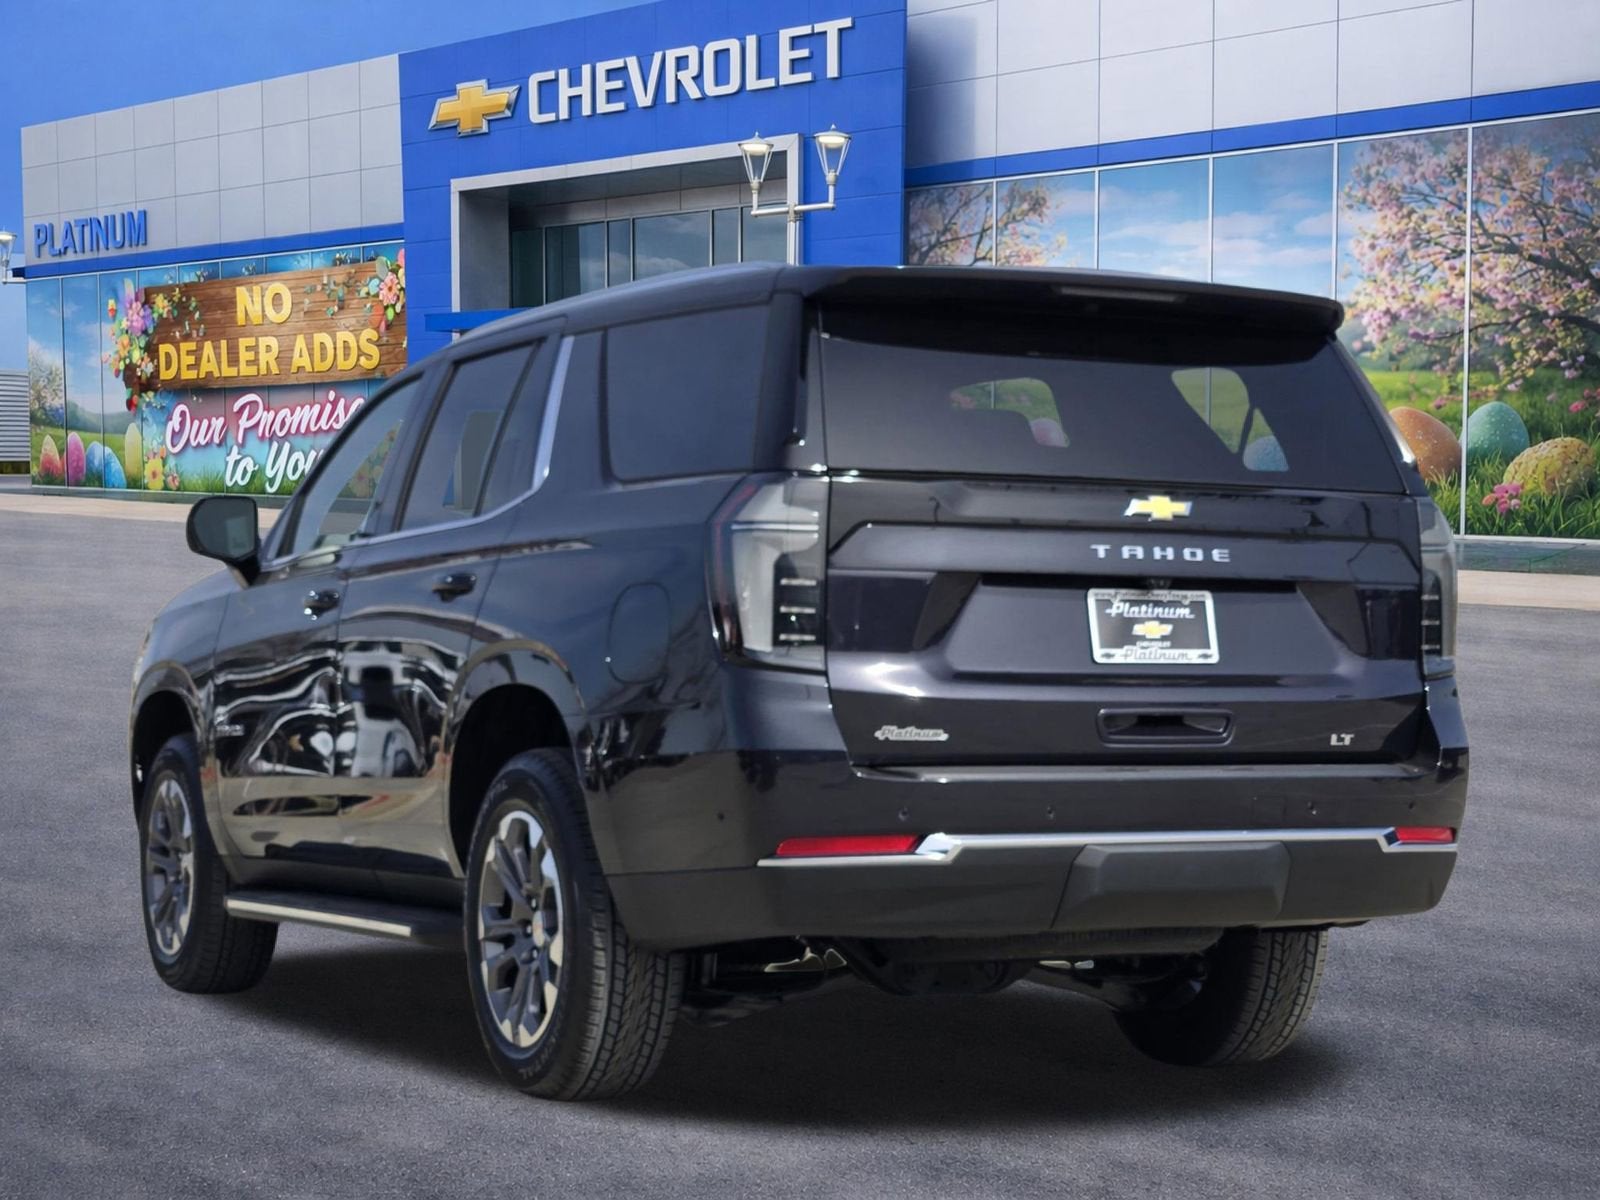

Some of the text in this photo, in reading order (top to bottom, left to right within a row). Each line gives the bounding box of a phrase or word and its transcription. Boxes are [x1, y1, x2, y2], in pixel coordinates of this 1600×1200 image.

[528, 17, 853, 124] CHEVROLET
[34, 209, 147, 258] PLATINUM
[236, 282, 293, 326] NO
[159, 328, 381, 381] DEALER ADDS
[166, 404, 227, 454] Our
[224, 444, 258, 487] to
[1090, 544, 1231, 562] TAHOE
[1105, 602, 1195, 618] Platinum
[873, 725, 949, 741] Platinum
[1330, 733, 1355, 746] LT
